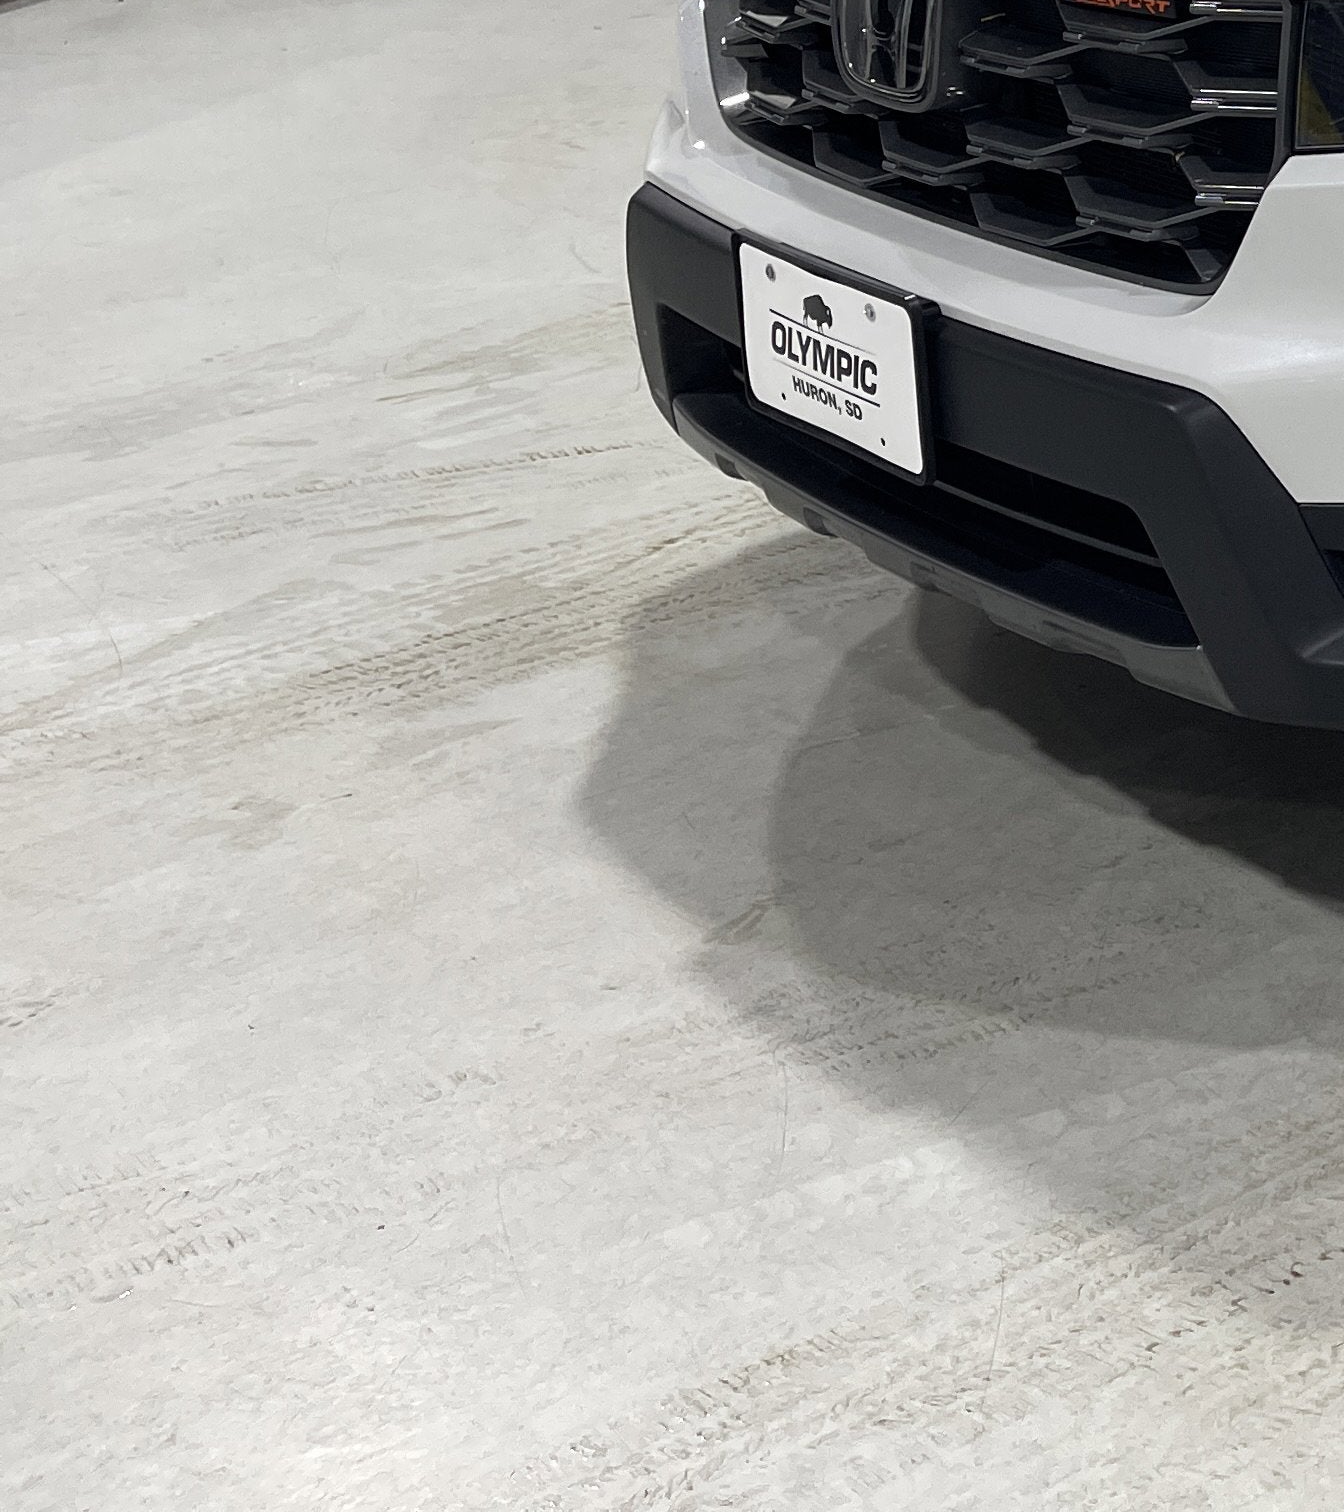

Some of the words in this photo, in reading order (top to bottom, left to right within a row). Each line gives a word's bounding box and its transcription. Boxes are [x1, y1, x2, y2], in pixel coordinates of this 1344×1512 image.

[770, 320, 878, 396] OLYMPIC
[792, 374, 842, 415] HURON,
[844, 399, 863, 421] SD
